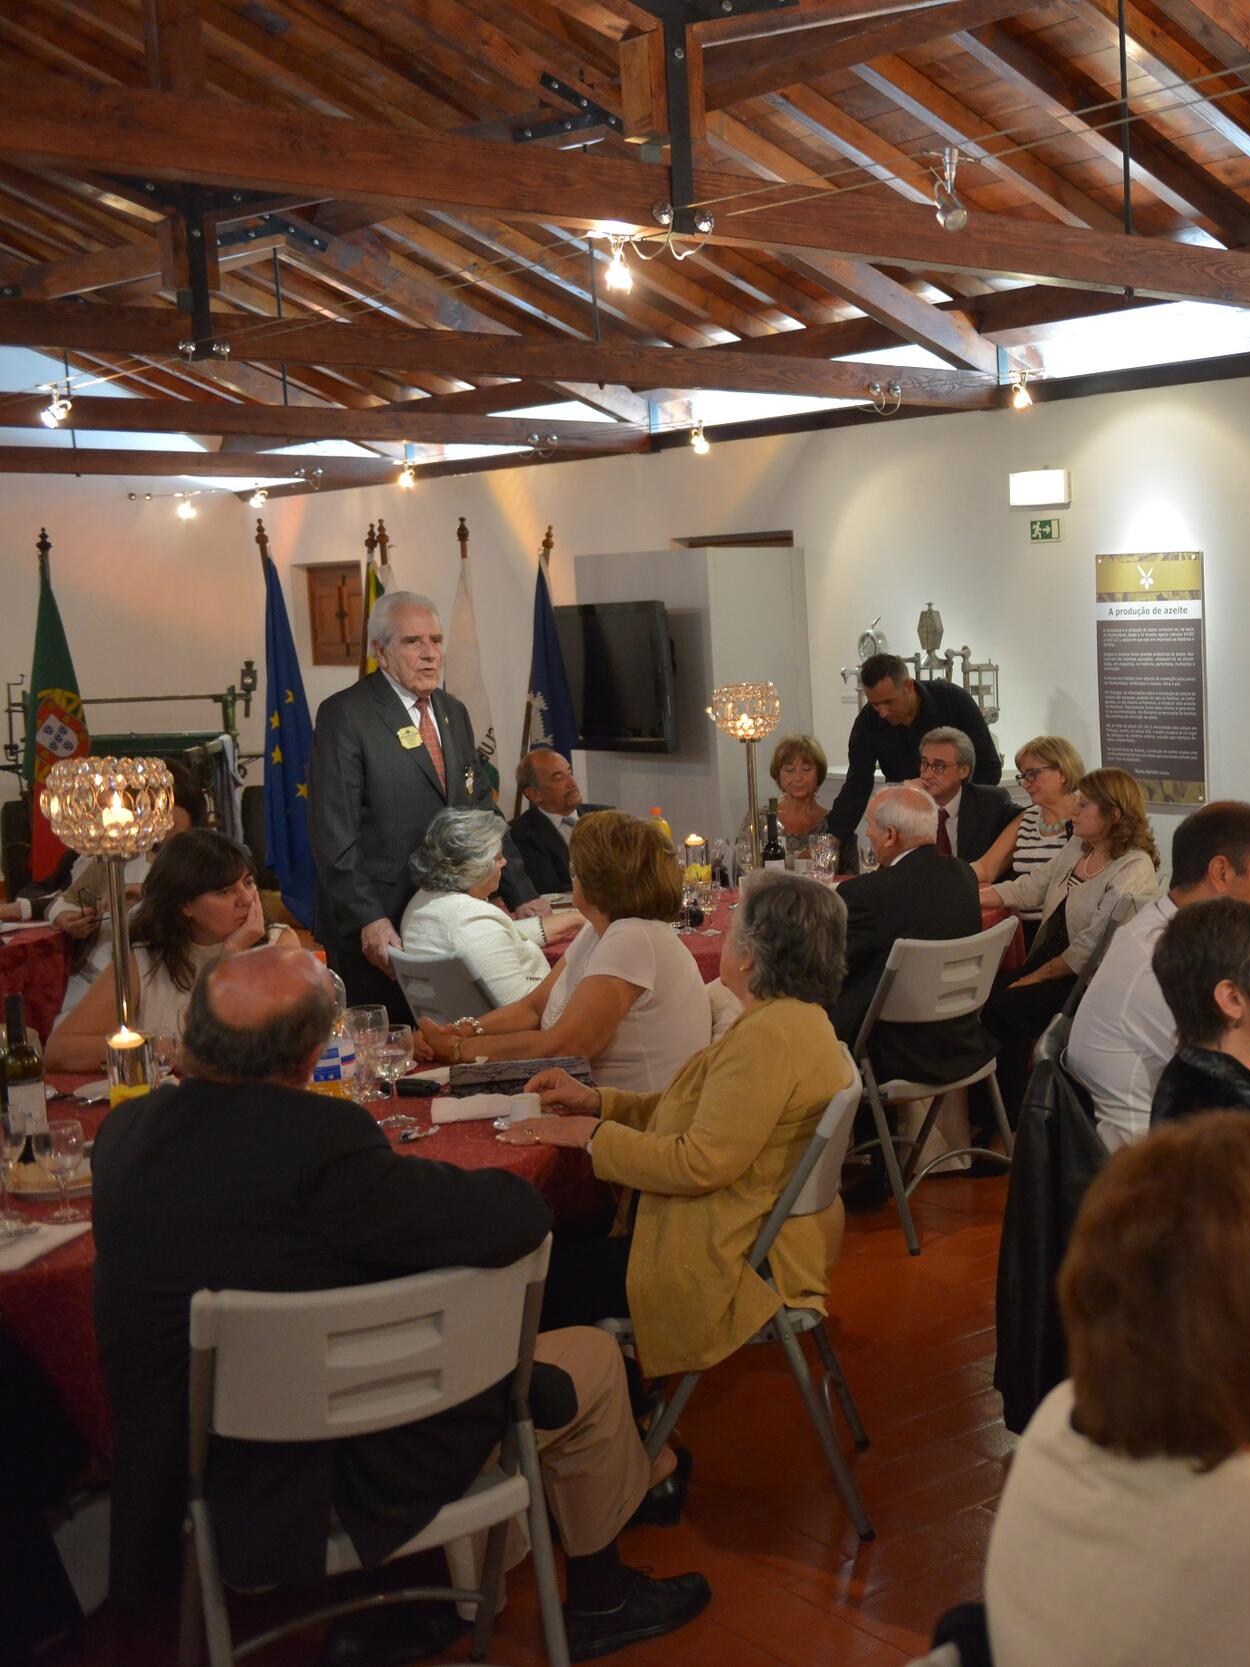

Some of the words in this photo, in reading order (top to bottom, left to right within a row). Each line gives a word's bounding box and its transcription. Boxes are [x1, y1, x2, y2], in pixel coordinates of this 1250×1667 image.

[1108, 607, 1114, 616] A
[1115, 606, 1150, 617] produção
[1152, 606, 1162, 615] de
[1163, 605, 1188, 615] azeite
